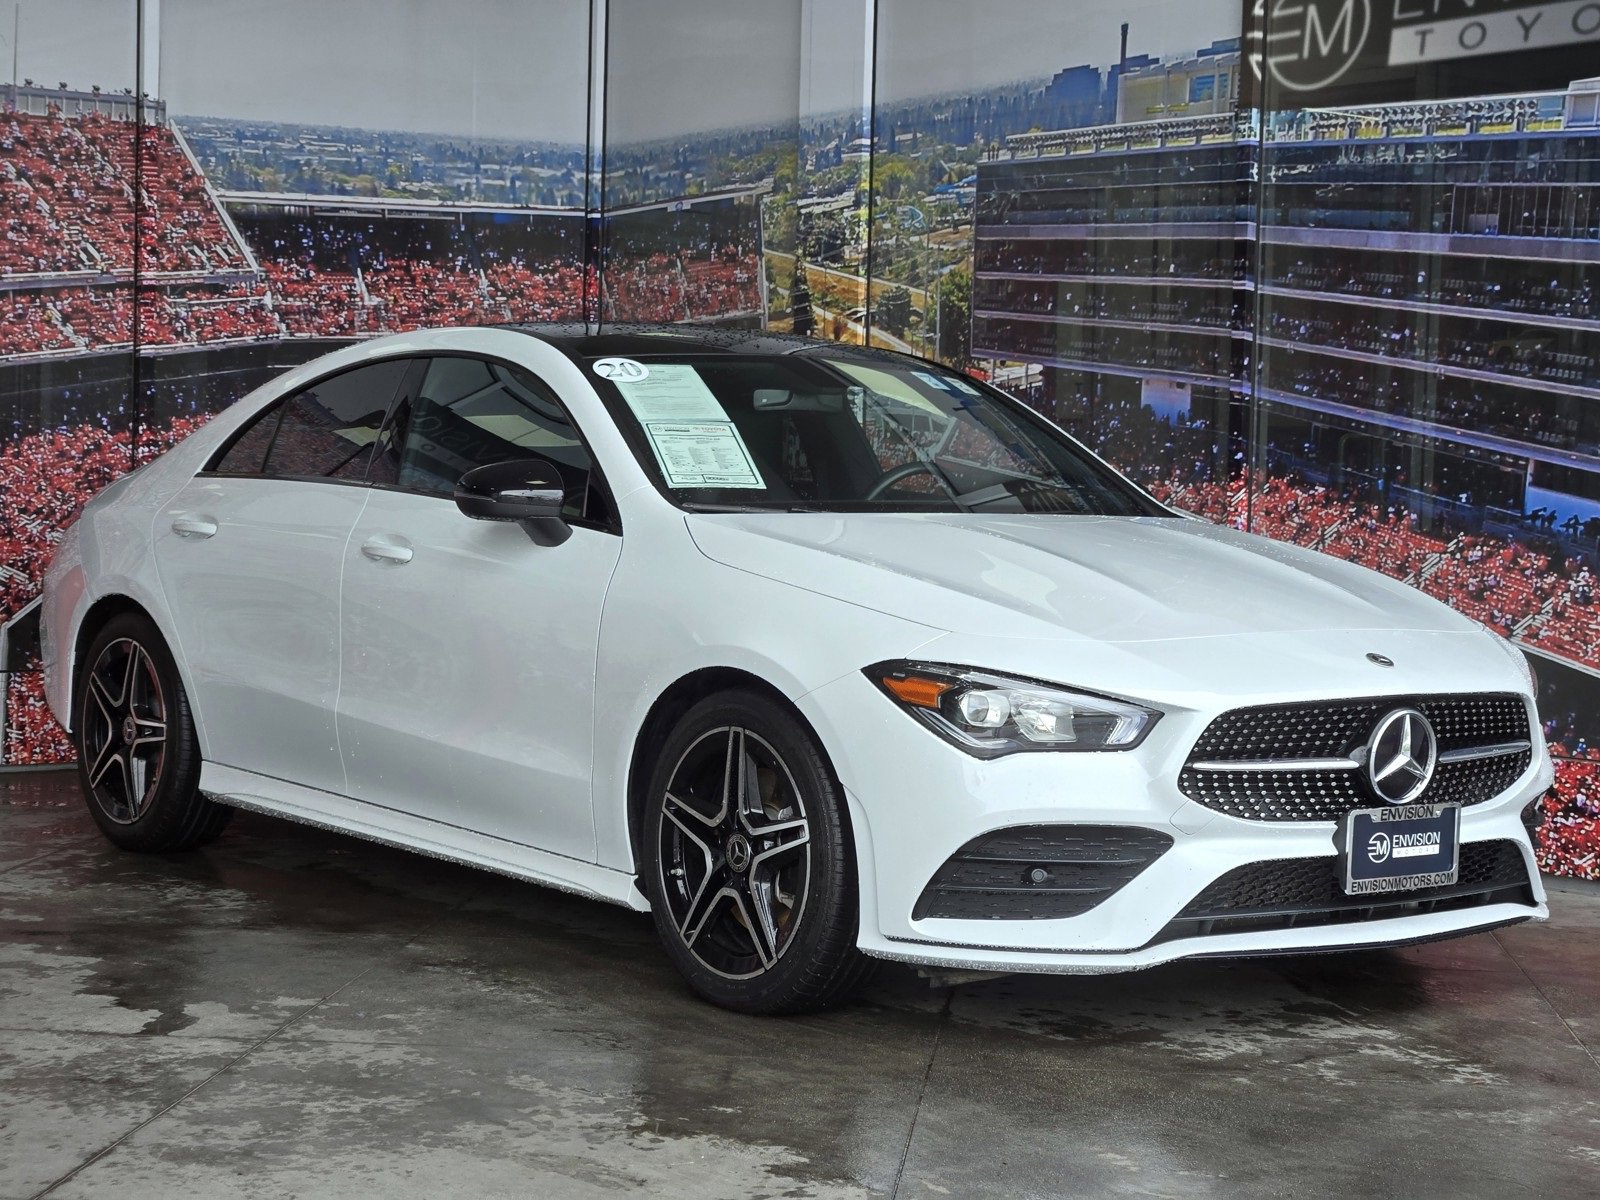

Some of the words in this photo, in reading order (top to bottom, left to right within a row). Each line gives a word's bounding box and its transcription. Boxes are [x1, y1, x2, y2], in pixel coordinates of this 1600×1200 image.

[598, 361, 643, 378] 20
[1381, 806, 1434, 821] ENVISION
[1393, 831, 1440, 848] ENVISION
[1351, 872, 1454, 893] ENVISIONMOTORS.COM
